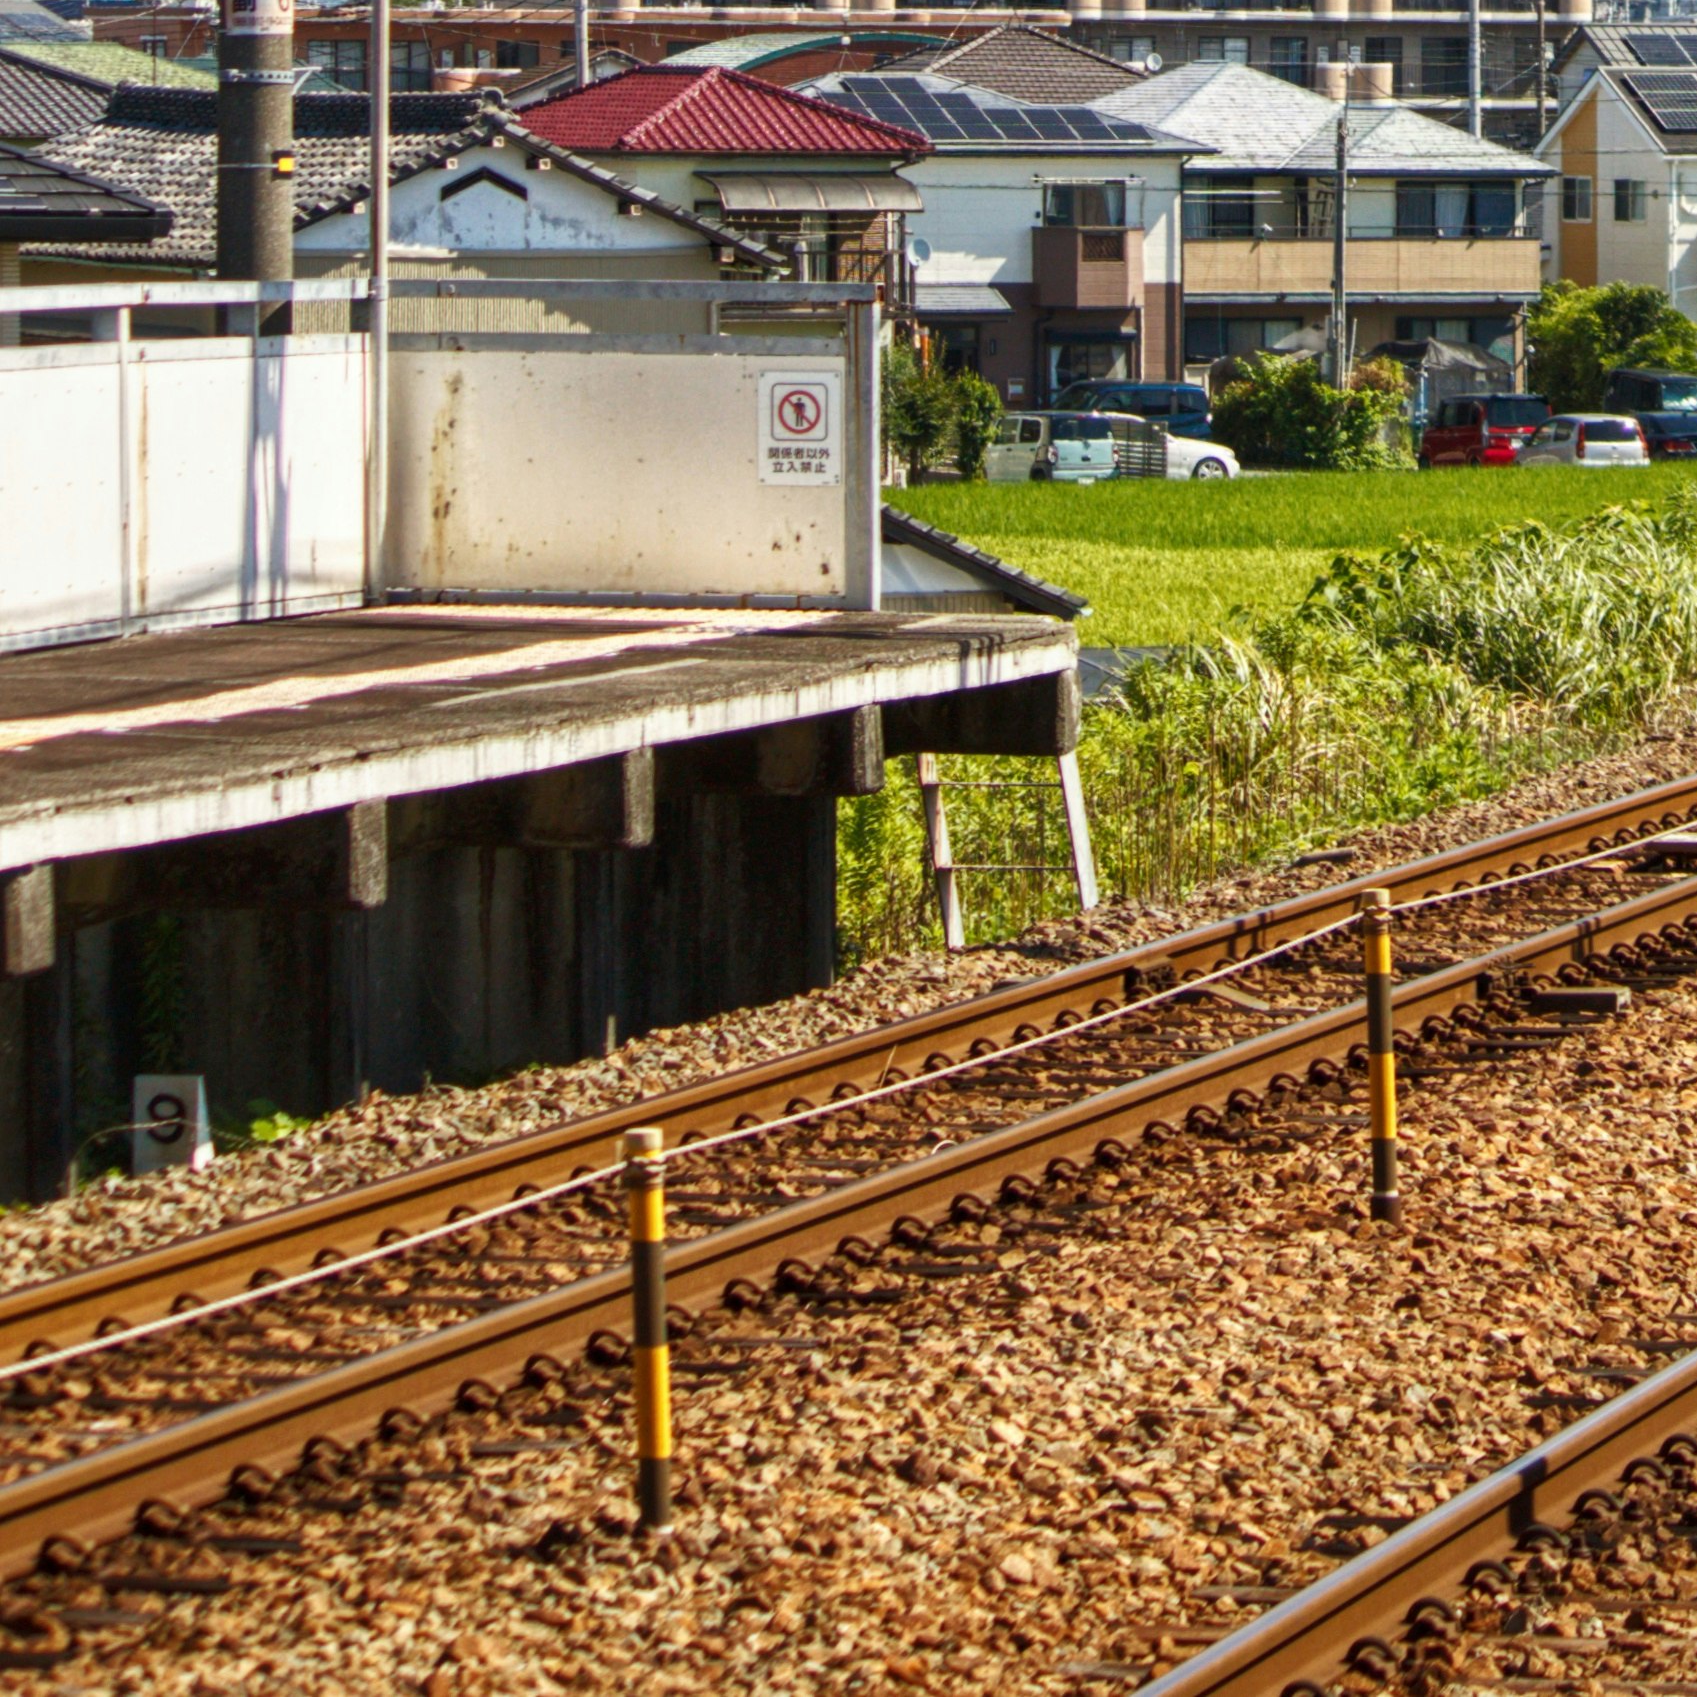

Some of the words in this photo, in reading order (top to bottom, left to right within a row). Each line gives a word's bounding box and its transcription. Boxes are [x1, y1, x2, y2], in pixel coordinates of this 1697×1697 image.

[767, 446, 830, 460] 関係者以外
[772, 460, 827, 474] 立入禁止
[147, 1093, 187, 1146] 9
